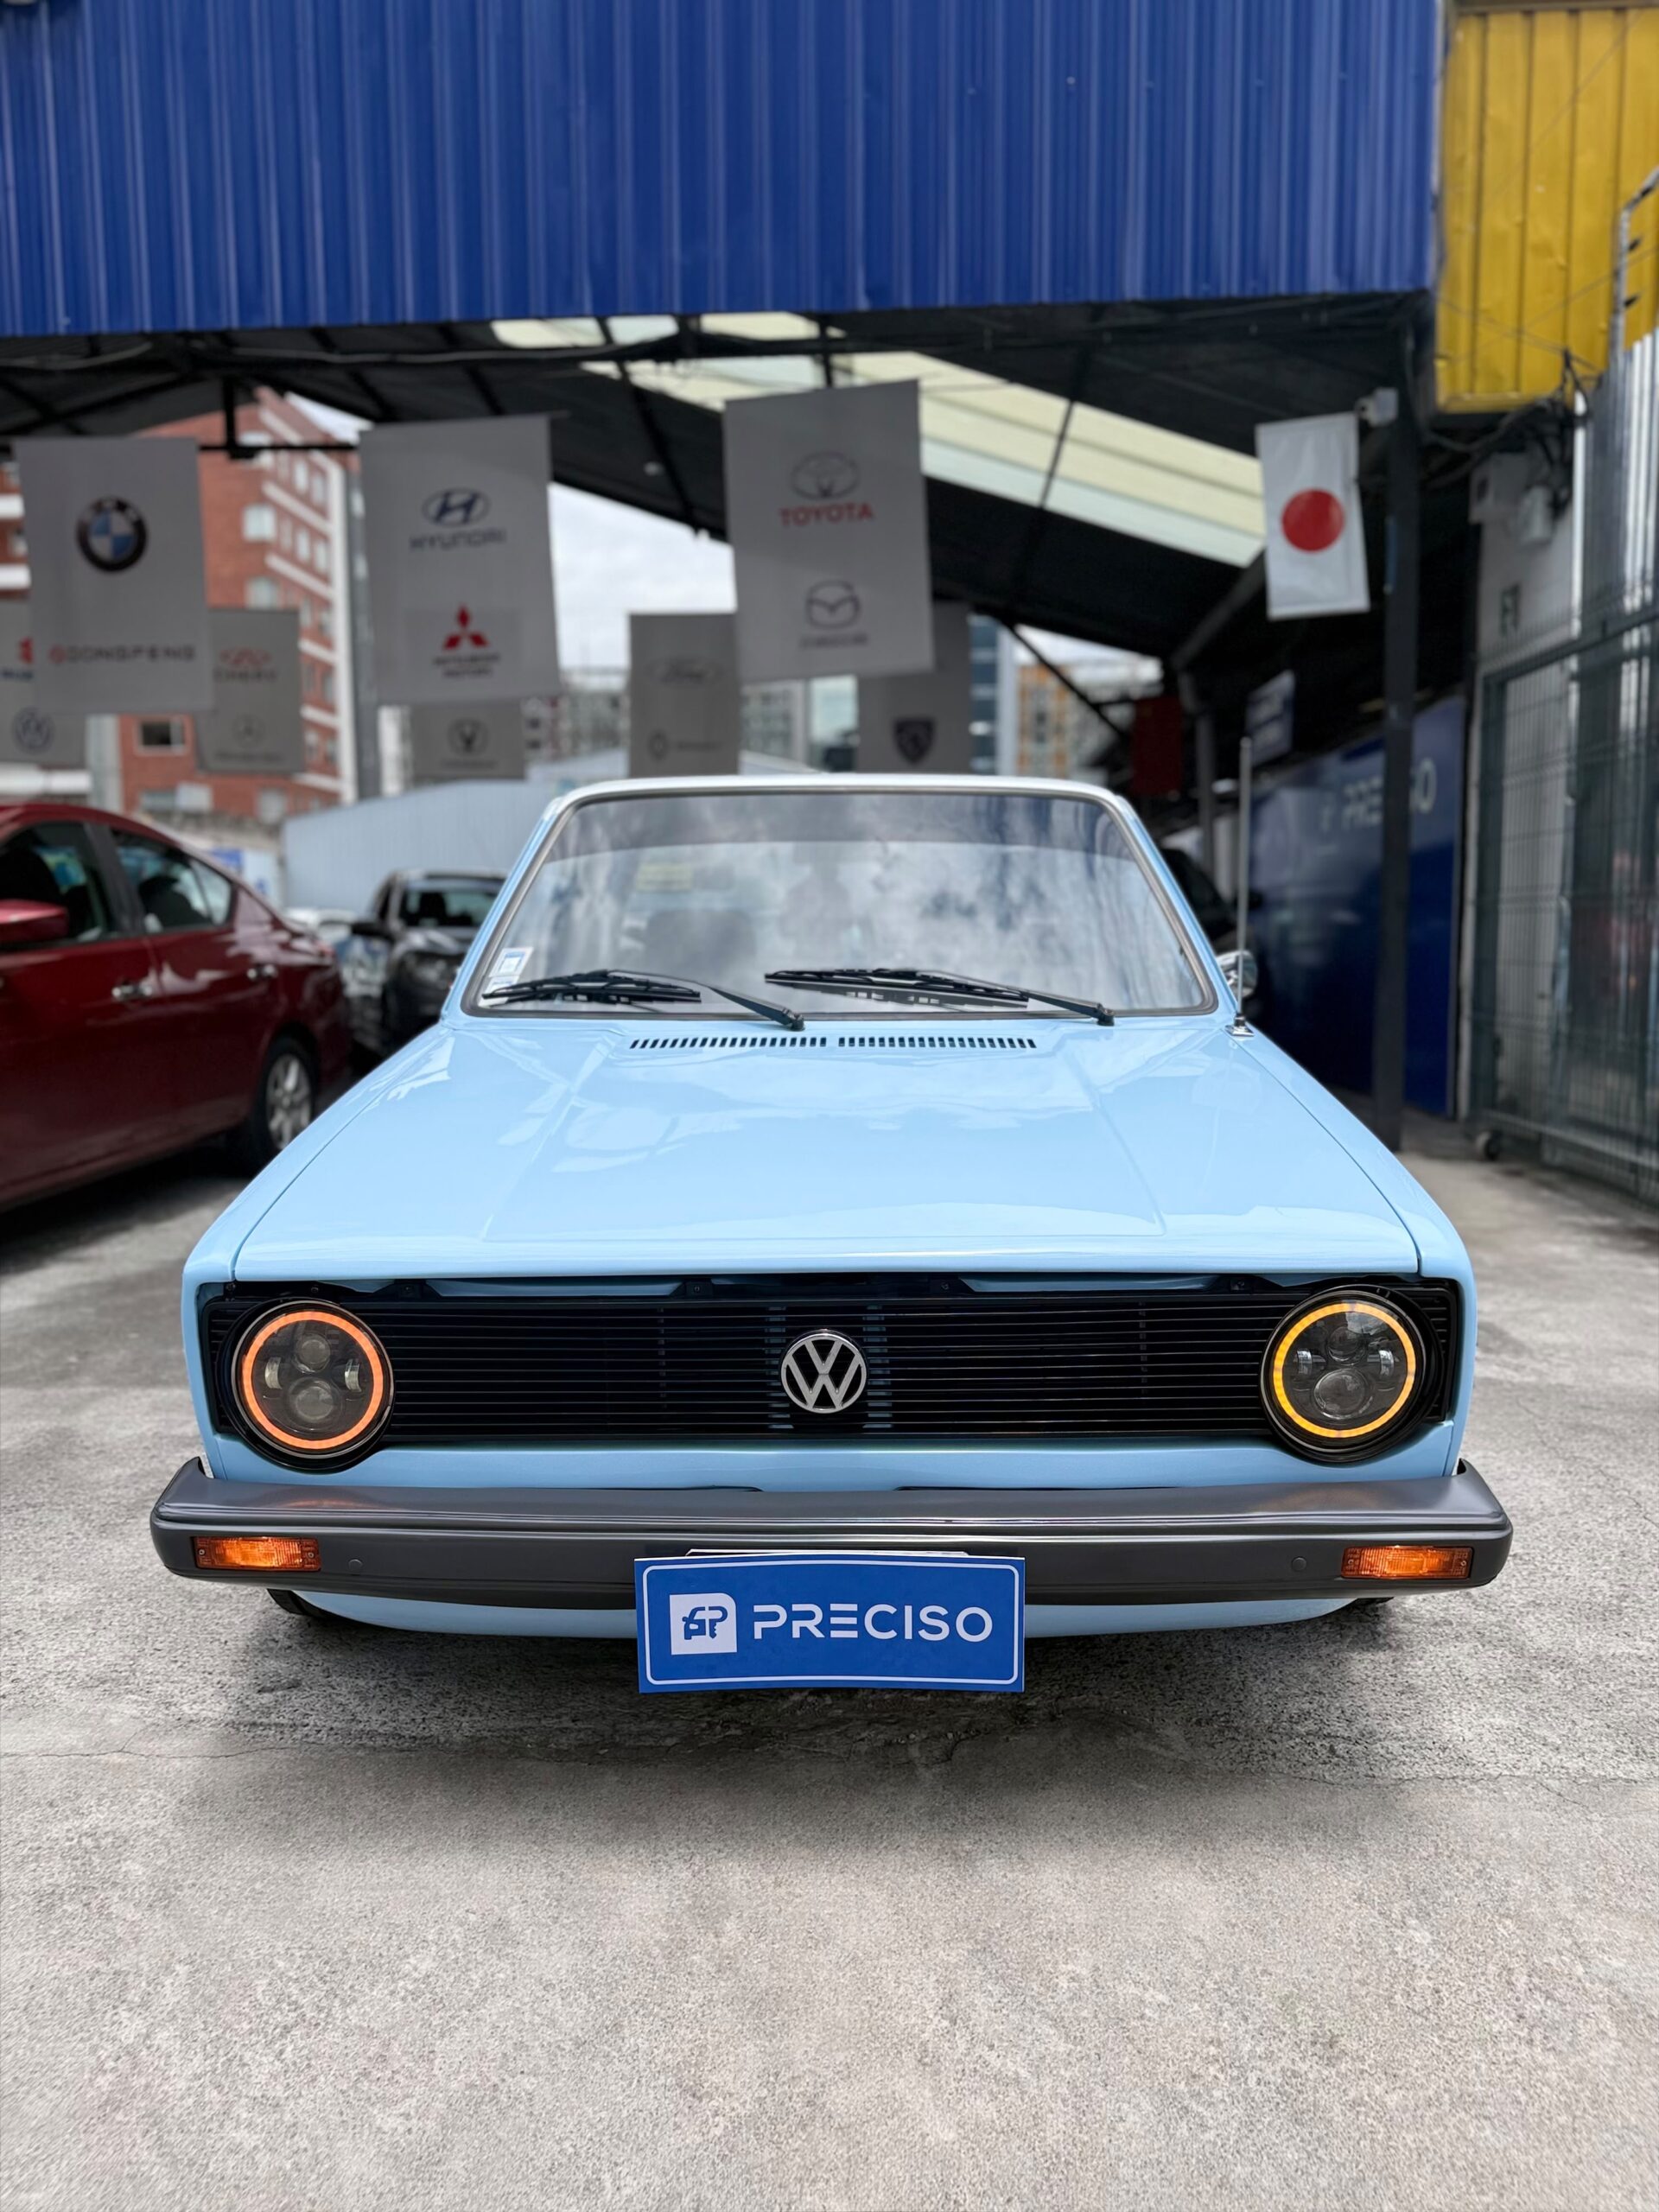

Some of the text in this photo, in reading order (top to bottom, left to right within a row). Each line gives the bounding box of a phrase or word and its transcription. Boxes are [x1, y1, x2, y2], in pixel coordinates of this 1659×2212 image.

[779, 503, 874, 527] TOYOTA
[410, 529, 506, 551] HYUNDAI
[753, 1603, 994, 1643] PRECISO
